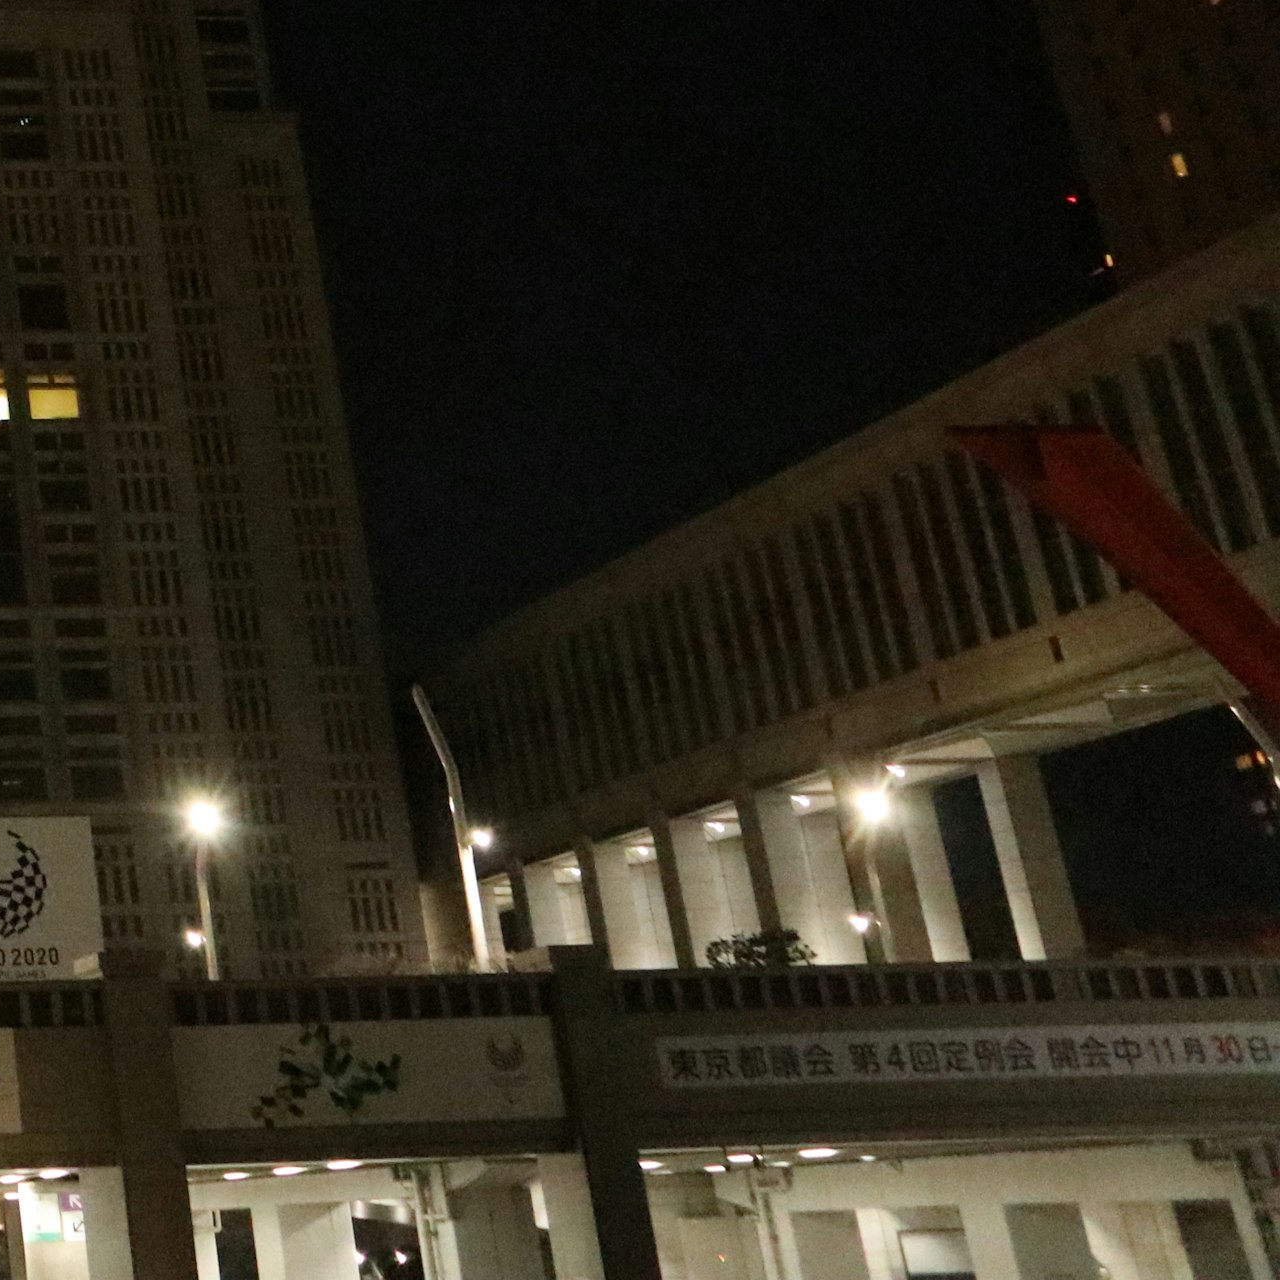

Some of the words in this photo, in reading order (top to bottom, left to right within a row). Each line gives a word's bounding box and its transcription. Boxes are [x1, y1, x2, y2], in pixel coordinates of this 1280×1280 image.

[10, 946, 59, 966] 2020
[668, 1042, 834, 1080] 東京都議会
[847, 1037, 1036, 1075] 第4回定例会
